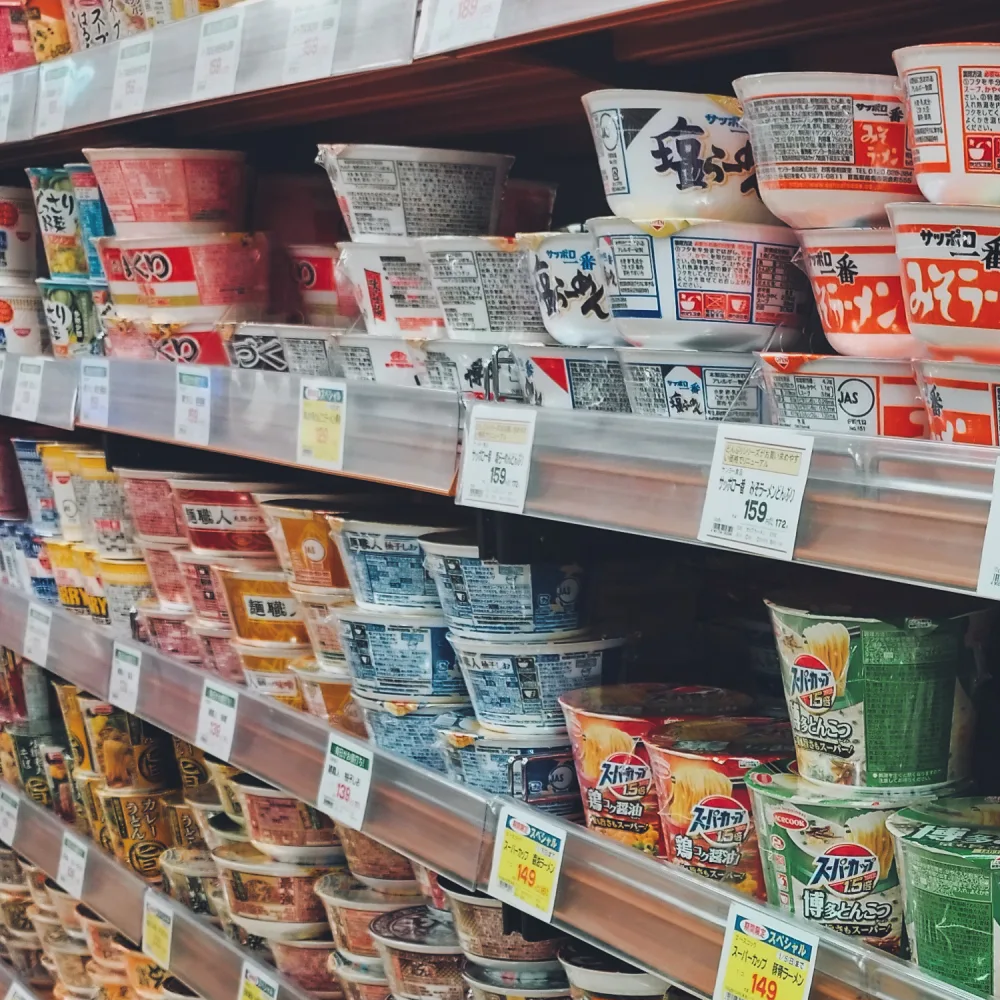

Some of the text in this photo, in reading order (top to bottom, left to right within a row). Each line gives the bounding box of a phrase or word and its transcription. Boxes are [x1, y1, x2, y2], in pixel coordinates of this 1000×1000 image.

[838, 391, 859, 405] JAS
[490, 466, 506, 484] 159
[743, 499, 768, 522] 159
[775, 518, 787, 528] 172
[790, 666, 833, 695] スーパーカップ
[808, 692, 833, 709] 1.5倍
[600, 763, 648, 786] スーパーカップ
[336, 782, 350, 801] 139
[623, 782, 646, 797] 1.5倍
[587, 788, 643, 818] 鶏コク醤油
[142, 798, 158, 839] カレー
[689, 805, 747, 833] スーパーカップ
[716, 828, 742, 843] 1.5倍
[674, 835, 740, 867] 鶏コク醤油
[517, 863, 537, 887] 149
[811, 856, 879, 887] スーパーカップ
[843, 876, 873, 894] 1.5倍
[803, 891, 892, 919] 博多とんこつ
[768, 931, 807, 957] スペシャル
